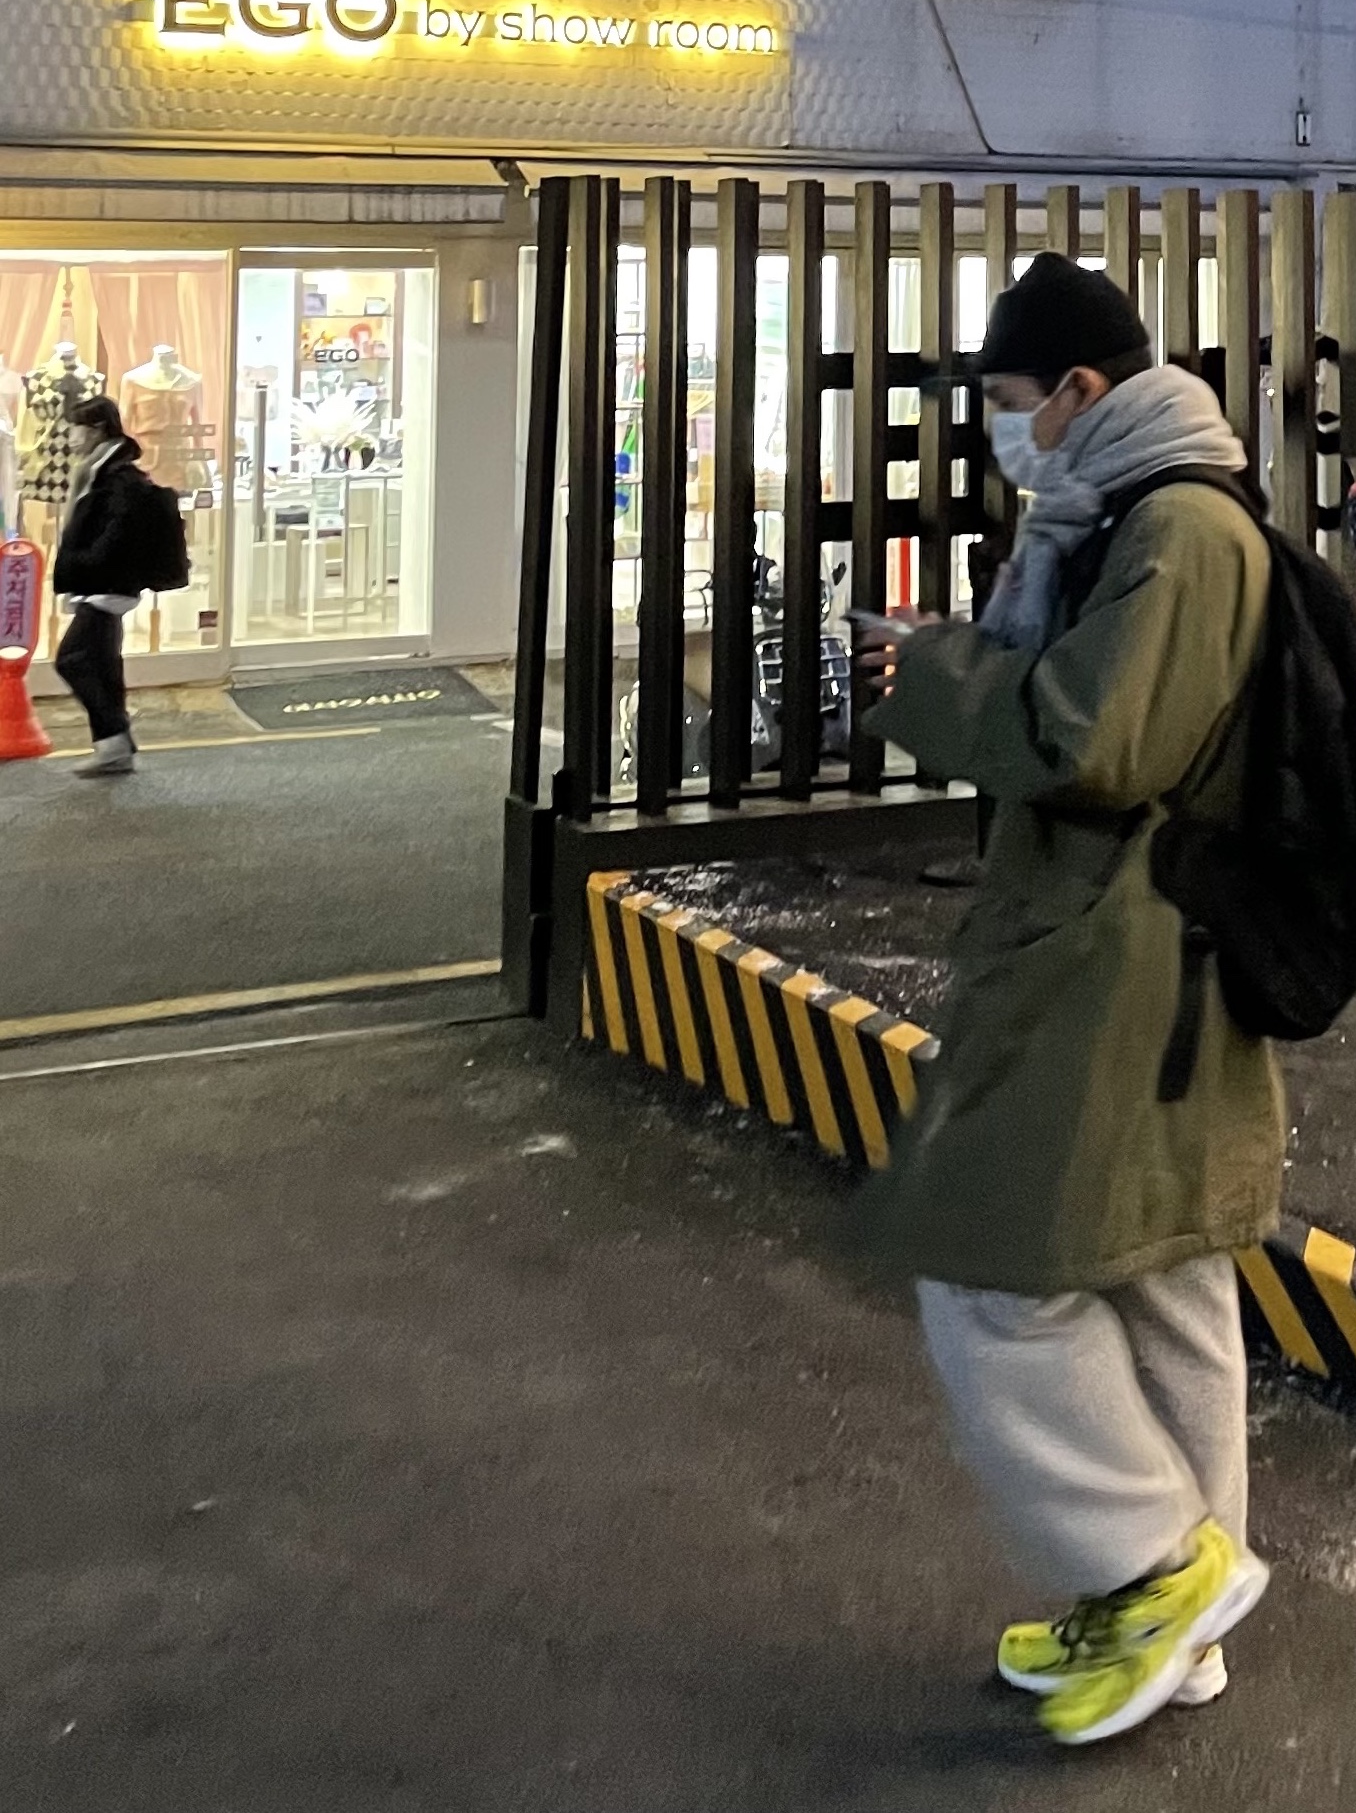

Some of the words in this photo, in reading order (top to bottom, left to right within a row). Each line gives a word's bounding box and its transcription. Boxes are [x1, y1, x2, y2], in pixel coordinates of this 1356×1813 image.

[500, 3, 635, 45] show
[652, 19, 775, 54] room
[314, 348, 360, 363] EGO
